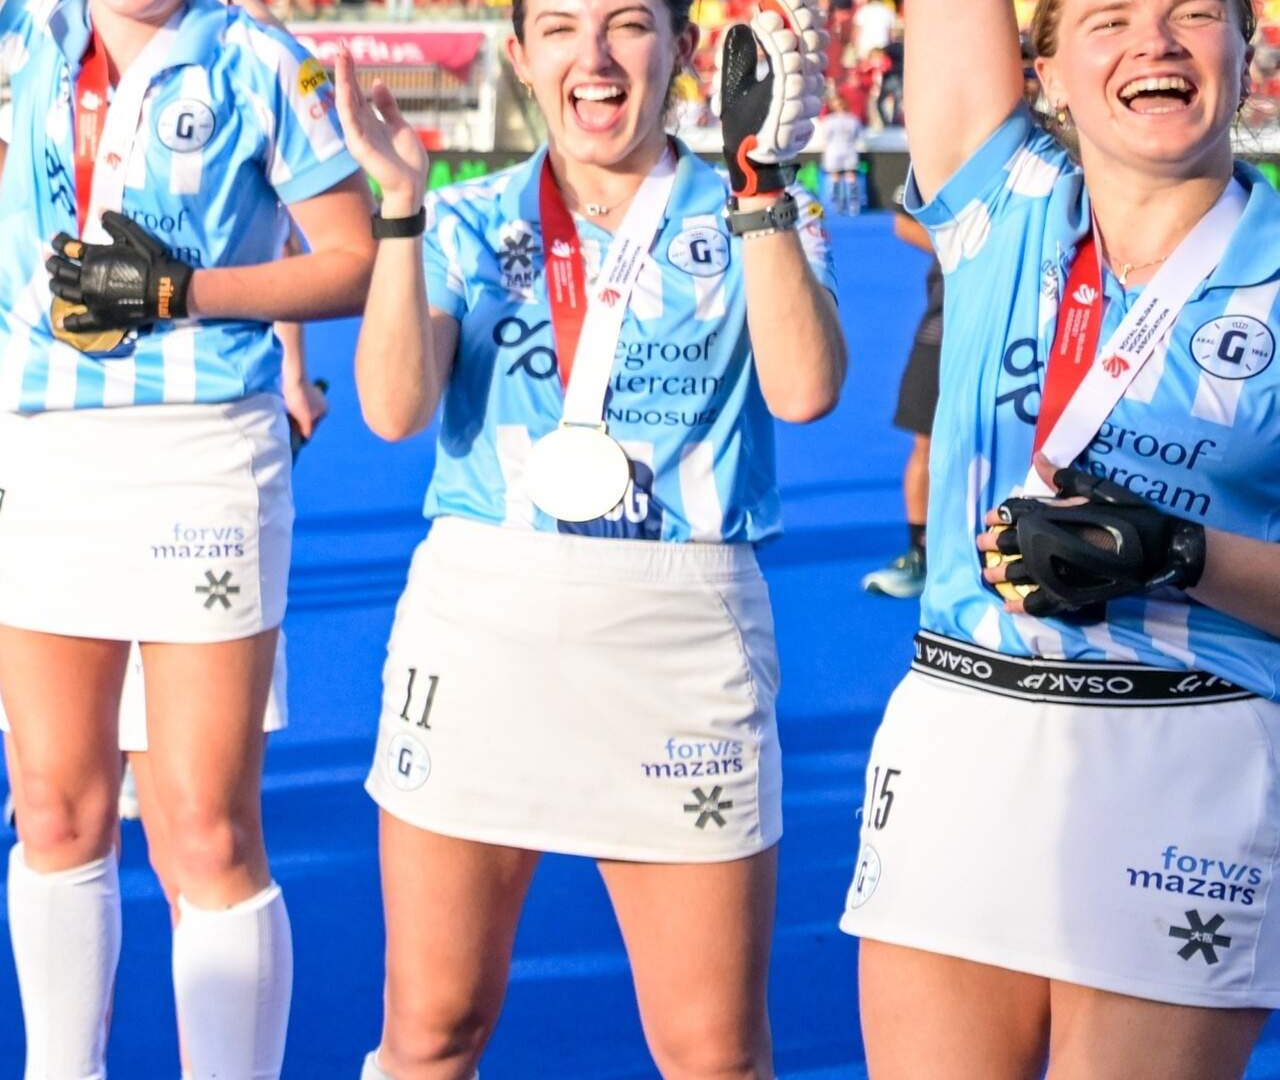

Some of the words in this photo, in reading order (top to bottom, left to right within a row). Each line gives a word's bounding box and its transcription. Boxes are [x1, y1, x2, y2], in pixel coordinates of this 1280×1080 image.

[690, 238, 713, 264] G
[1217, 329, 1248, 365] G
[1092, 421, 1217, 470] groof
[172, 522, 245, 543] forvis
[150, 542, 246, 559] mazars
[926, 644, 993, 679] OSAKA
[399, 667, 440, 731] 11
[397, 747, 412, 778] G
[665, 737, 743, 761] forvis
[641, 756, 744, 780] mazars
[867, 765, 902, 831] 15
[1160, 845, 1263, 886] forvis
[1126, 867, 1257, 906] mazars
